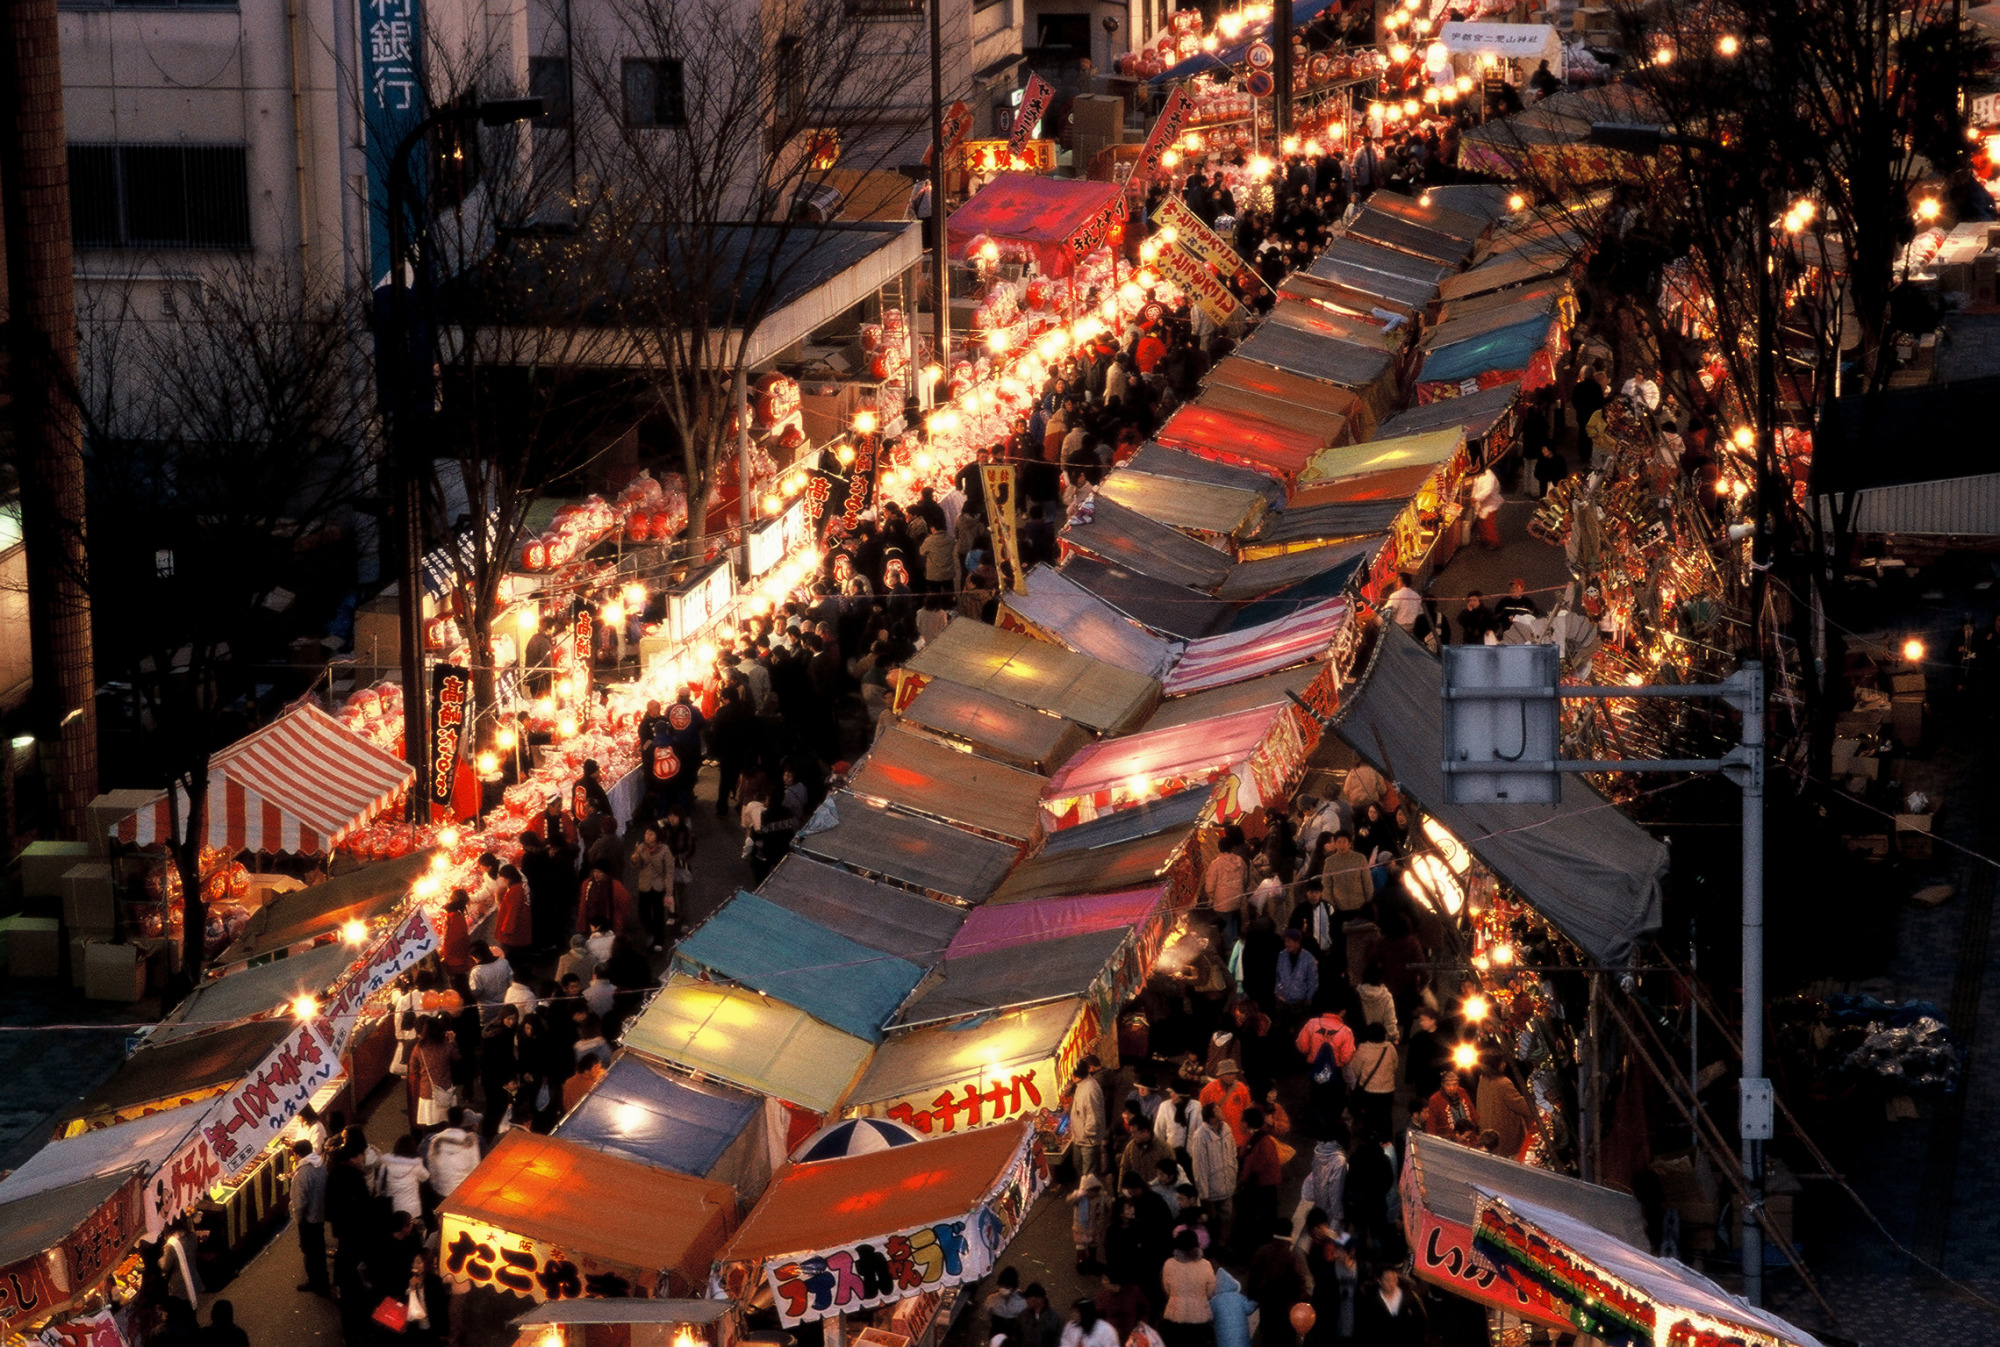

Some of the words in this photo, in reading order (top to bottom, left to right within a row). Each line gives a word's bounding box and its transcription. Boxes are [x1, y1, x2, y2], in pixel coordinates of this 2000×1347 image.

[1450, 32, 1538, 45] 宇都宮二荒山神社
[1252, 50, 1268, 62] 40
